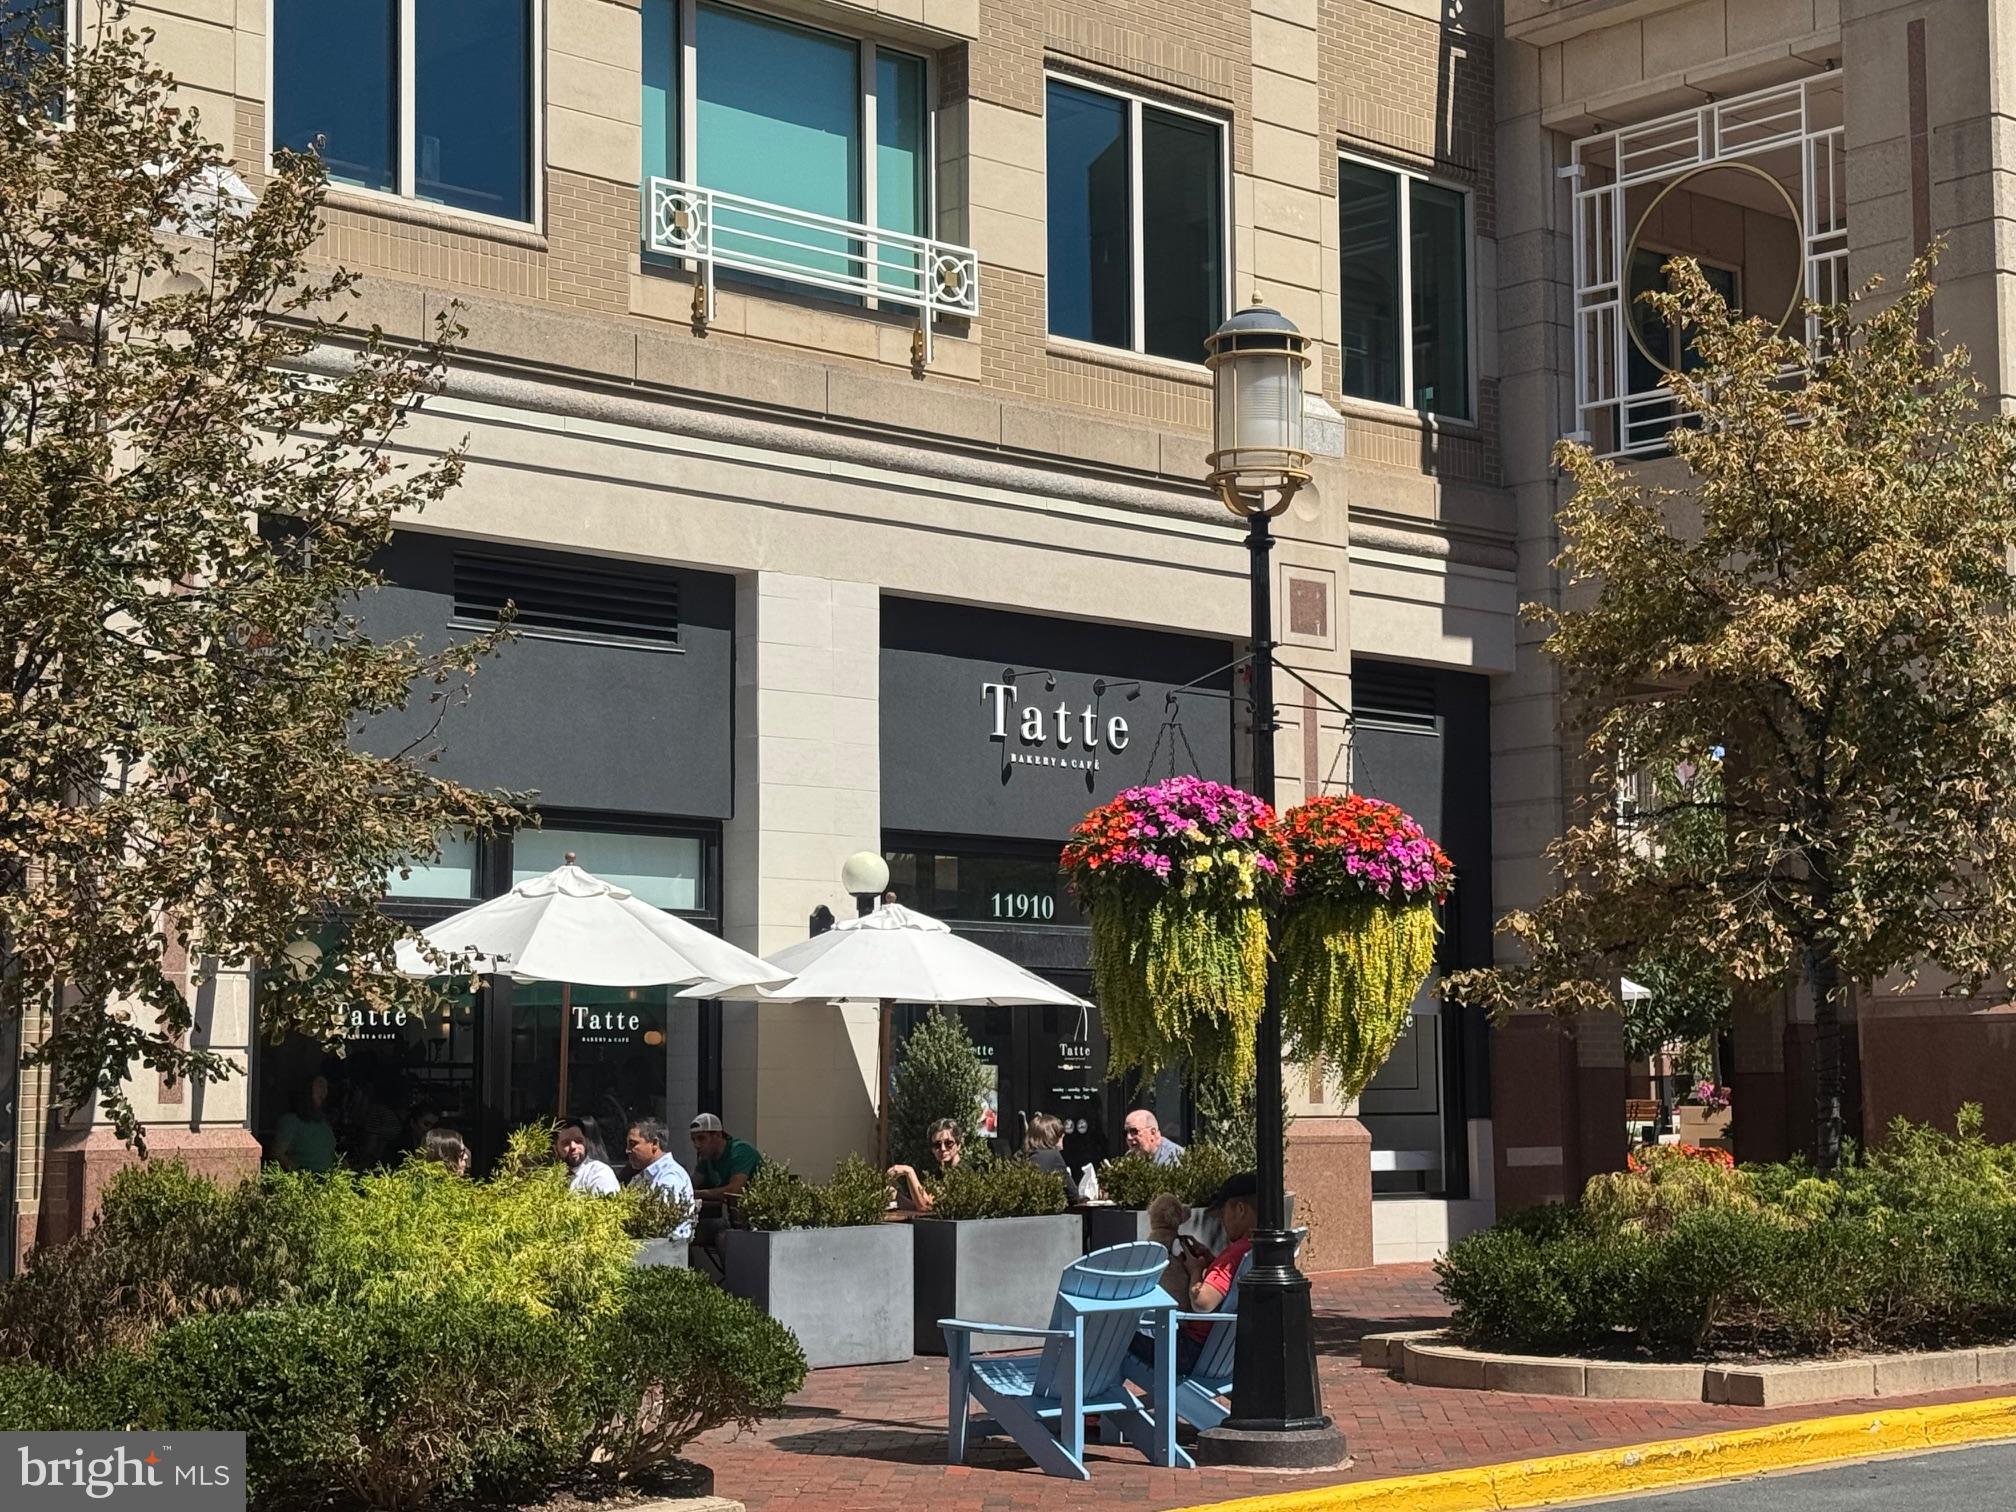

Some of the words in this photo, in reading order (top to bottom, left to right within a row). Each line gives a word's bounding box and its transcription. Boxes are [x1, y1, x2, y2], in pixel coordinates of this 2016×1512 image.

[982, 682, 1130, 750] Tatte
[1010, 753, 1057, 767] BAKERY
[1060, 758, 1068, 768] &
[991, 892, 1055, 920] 11910
[572, 1006, 640, 1031] Tatte
[1059, 1043, 1091, 1057] Tatte
